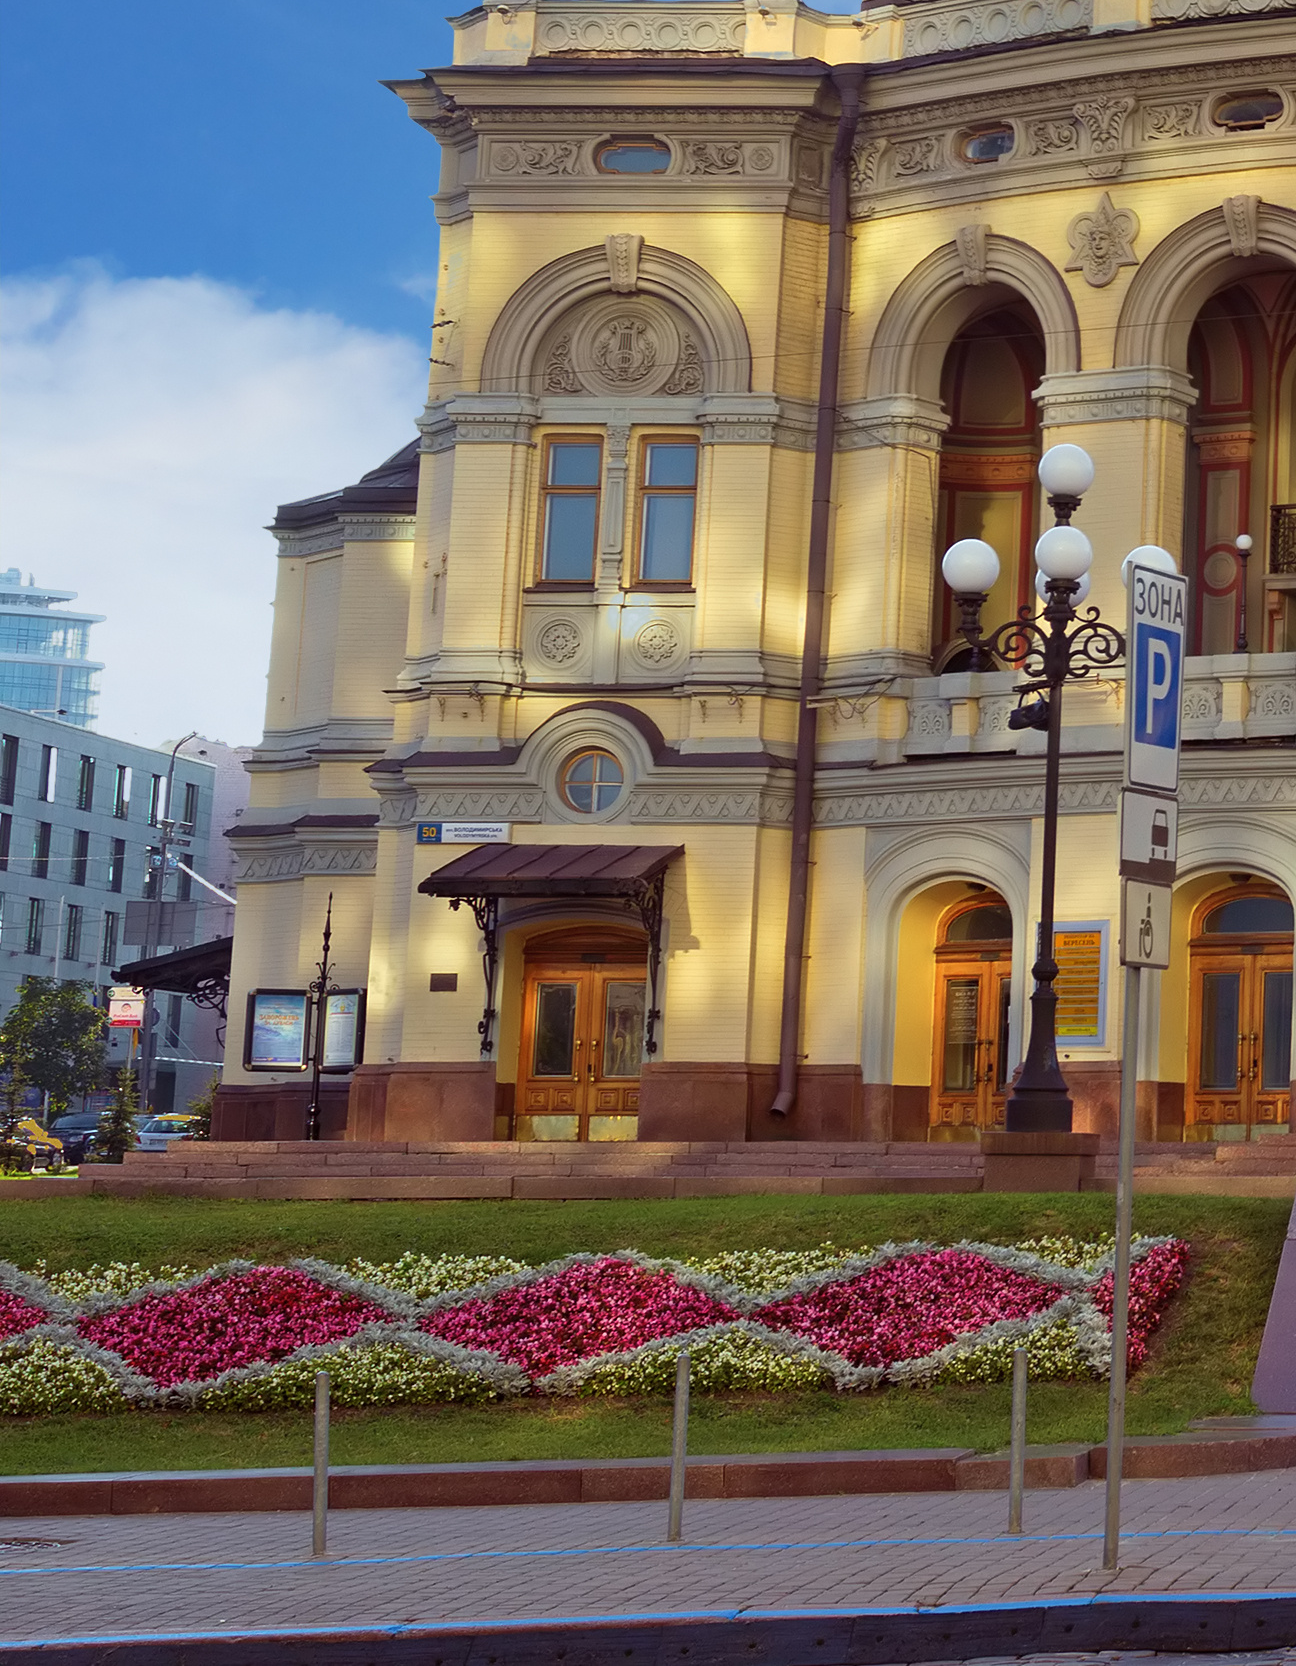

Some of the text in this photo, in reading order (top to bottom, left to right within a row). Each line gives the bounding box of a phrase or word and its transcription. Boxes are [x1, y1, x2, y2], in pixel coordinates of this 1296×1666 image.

[1134, 576, 1185, 627] ЗОНА
[1146, 636, 1172, 735] P
[423, 827, 436, 837] 50
